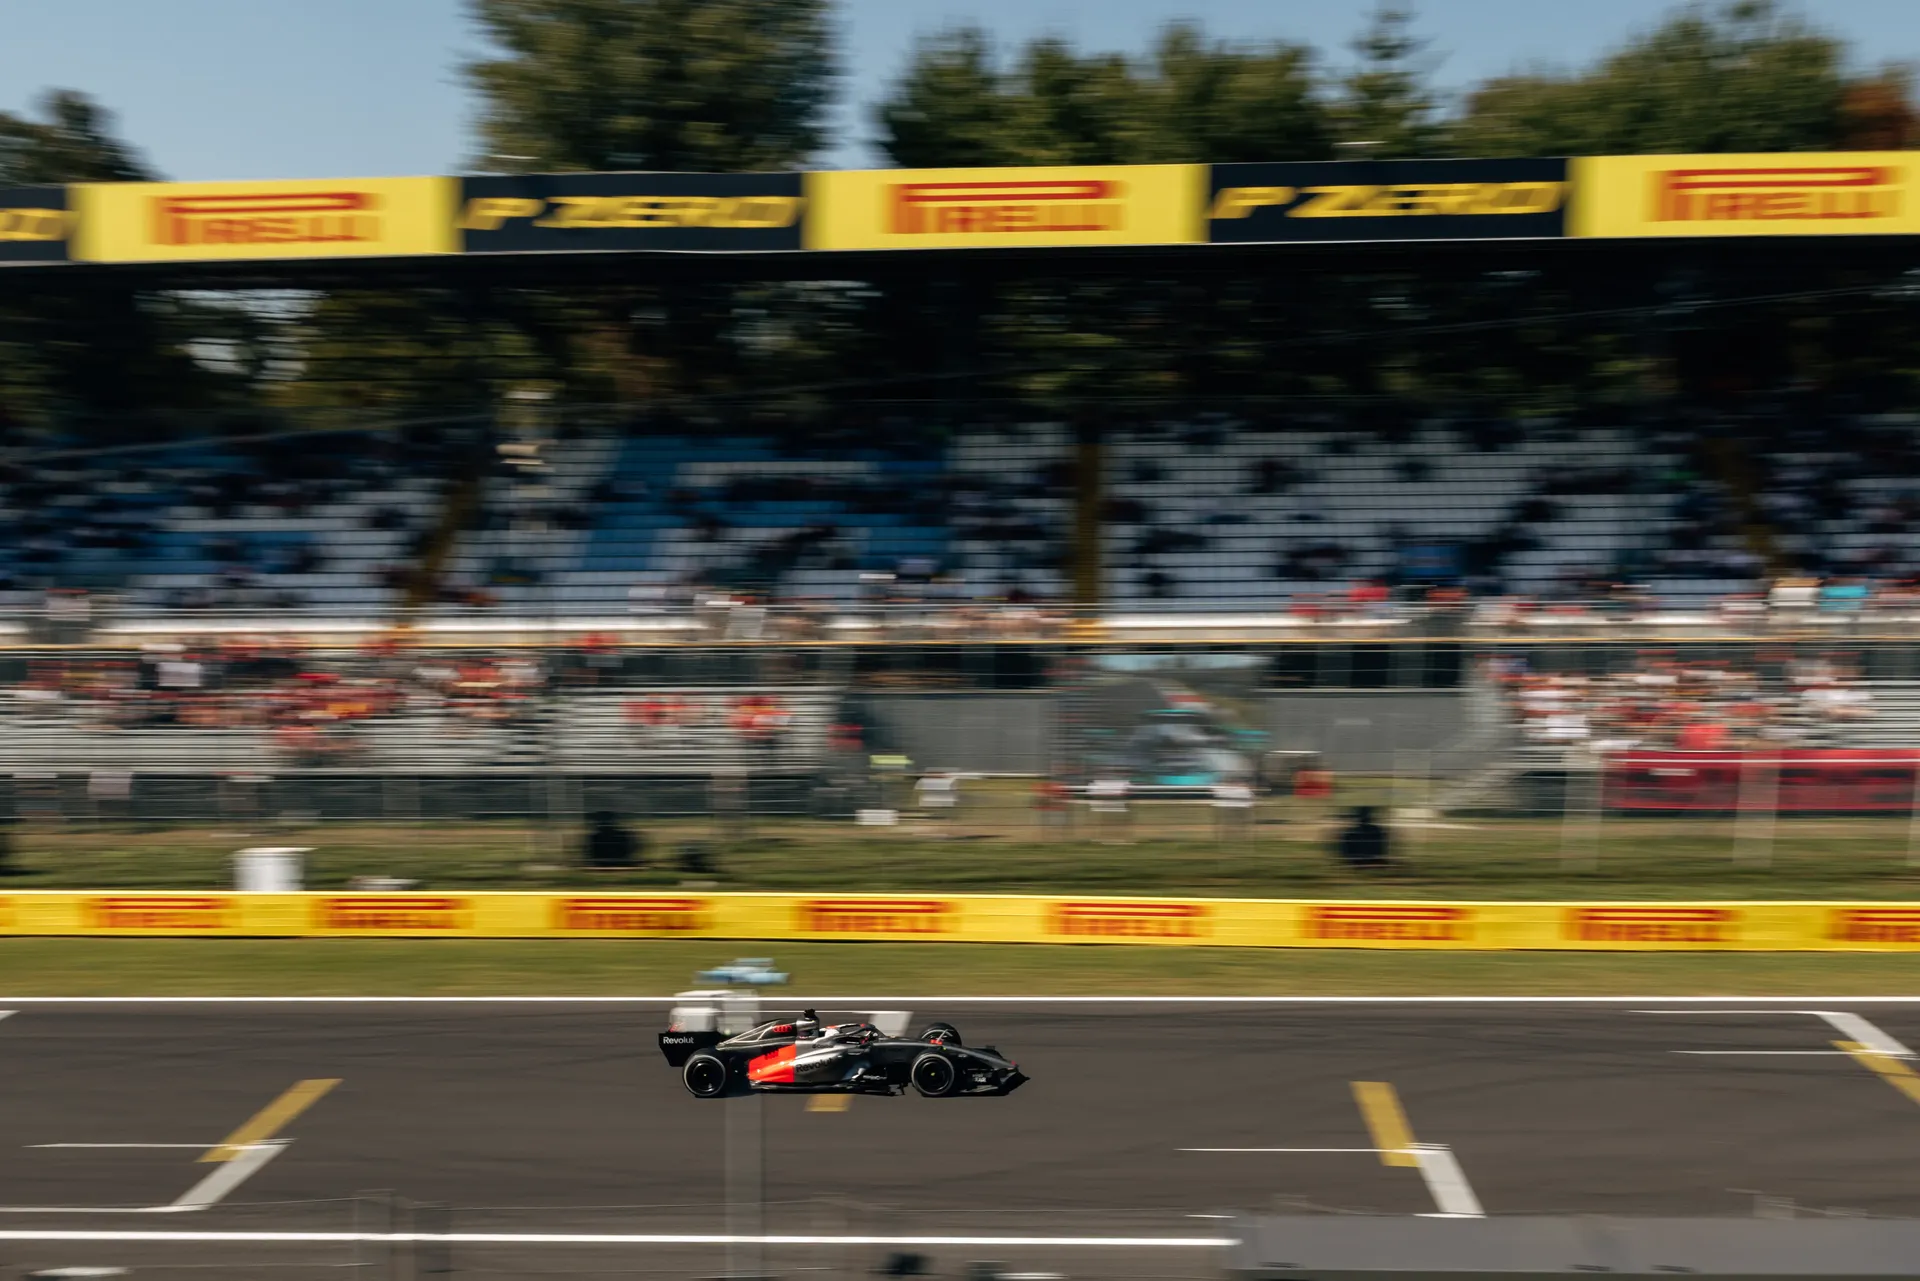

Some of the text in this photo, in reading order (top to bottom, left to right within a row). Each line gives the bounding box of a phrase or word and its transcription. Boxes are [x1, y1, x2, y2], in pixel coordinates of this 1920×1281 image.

[535, 195, 802, 229] ZERO
[881, 180, 1126, 234] PIRELLI
[1283, 181, 1567, 219] ZERO
[1645, 166, 1904, 222] PIRELLI
[145, 192, 381, 245] PIRELLI
[663, 1036, 694, 1045] Revolut
[795, 1057, 832, 1073] Revolut
